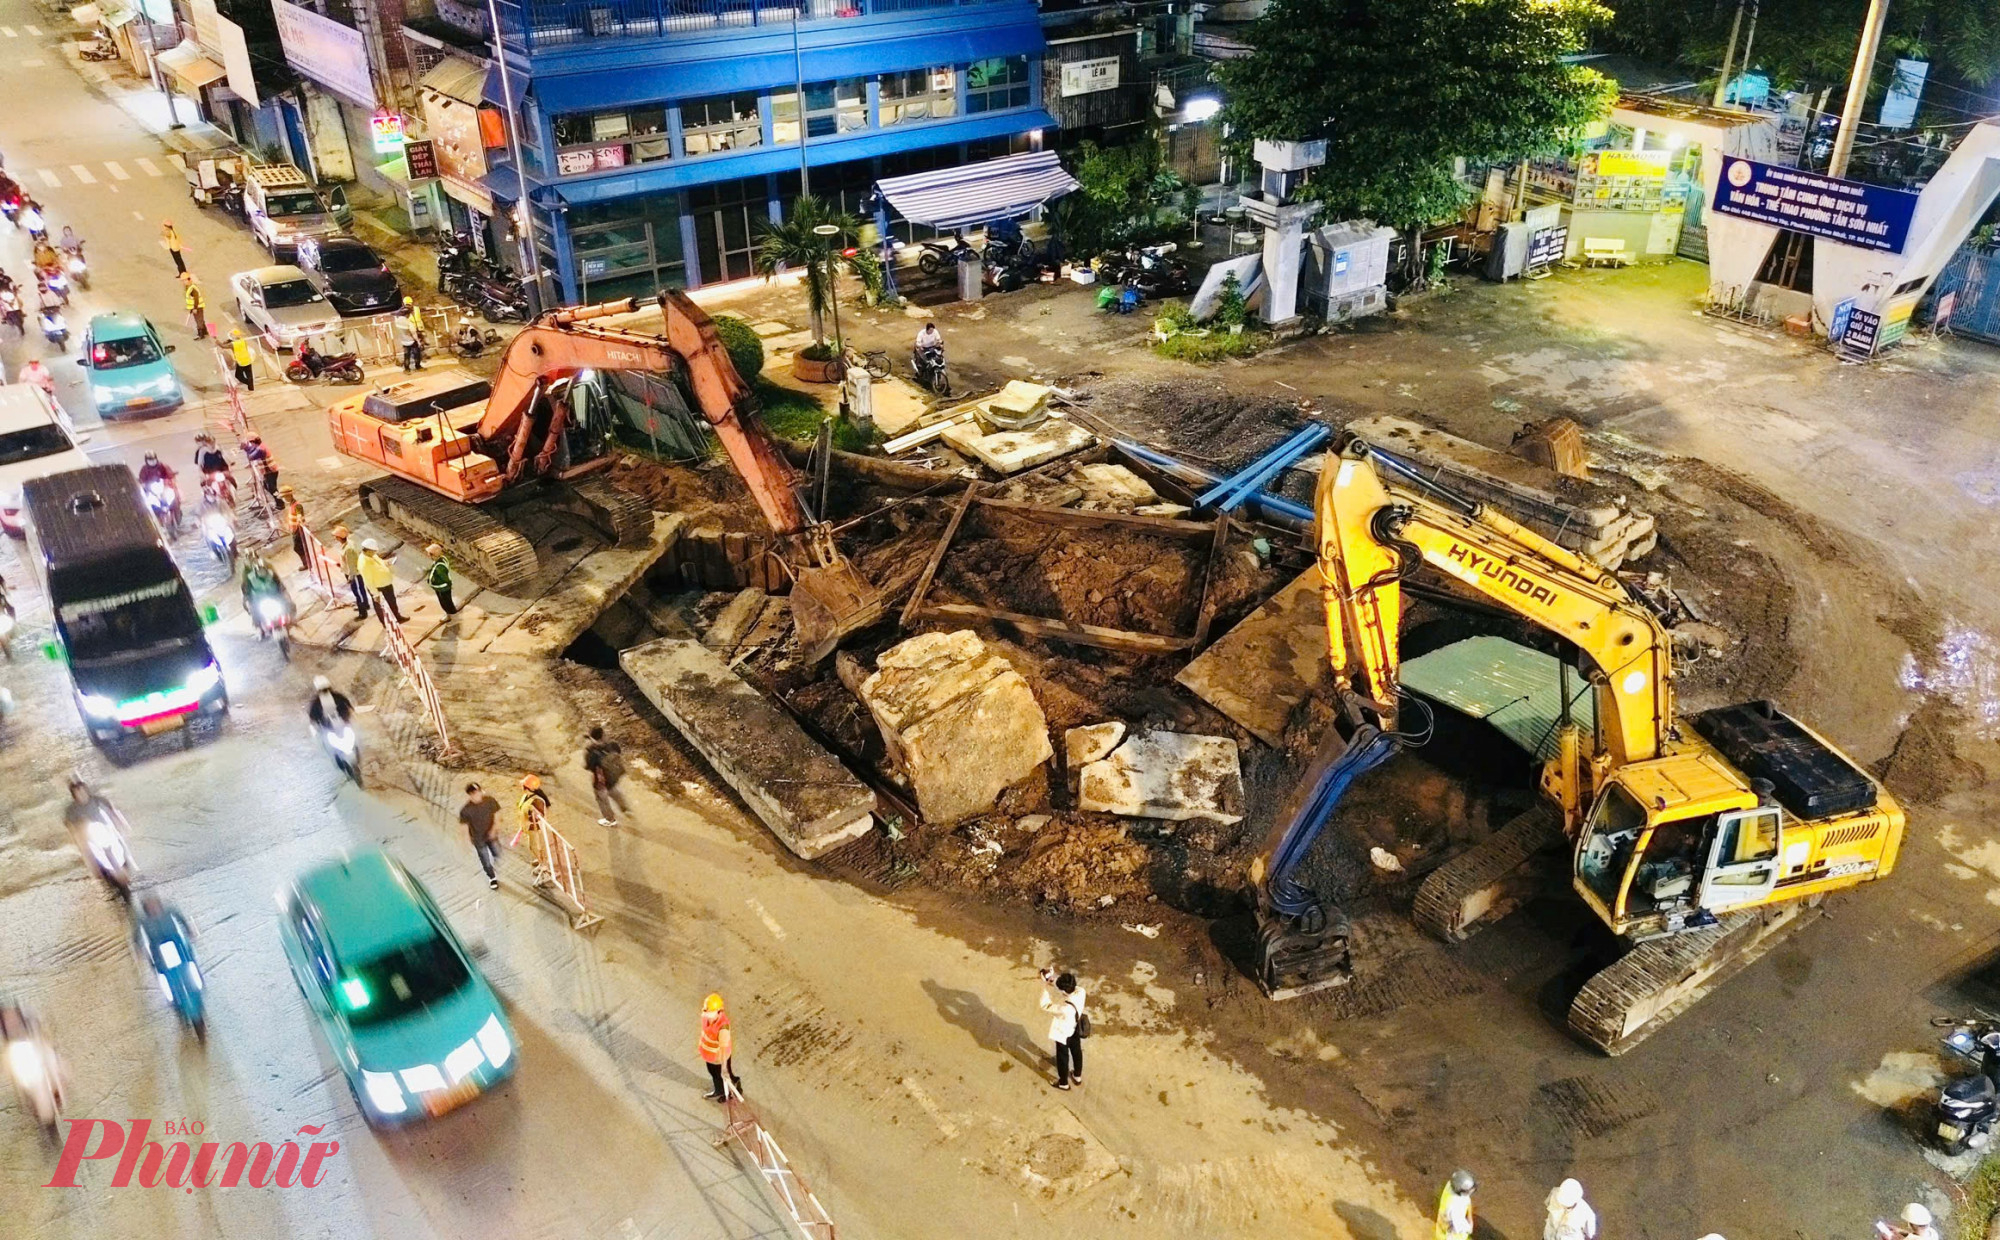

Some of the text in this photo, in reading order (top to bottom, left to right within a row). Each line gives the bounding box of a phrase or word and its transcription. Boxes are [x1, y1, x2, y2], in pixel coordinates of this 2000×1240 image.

[415, 168, 433, 176] LAN
[1755, 181, 1868, 218] TRUNG TÂM CUNG ỨNG DỊCH VỤ
[1729, 189, 1746, 204] VĂN
[1780, 202, 1800, 216] THAO
[1799, 206, 1832, 224] PHƯỜNG
[1847, 217, 1867, 231] SƠN
[1865, 221, 1889, 236] NHẤT
[1851, 310, 1878, 326] LỐI VÀO
[1850, 321, 1864, 331] GIỮ
[1863, 325, 1873, 334] XE
[1846, 330, 1872, 344] 2 BÁNH
[607, 351, 641, 361] HITACHI
[1448, 544, 1558, 607] HYUNDAI
